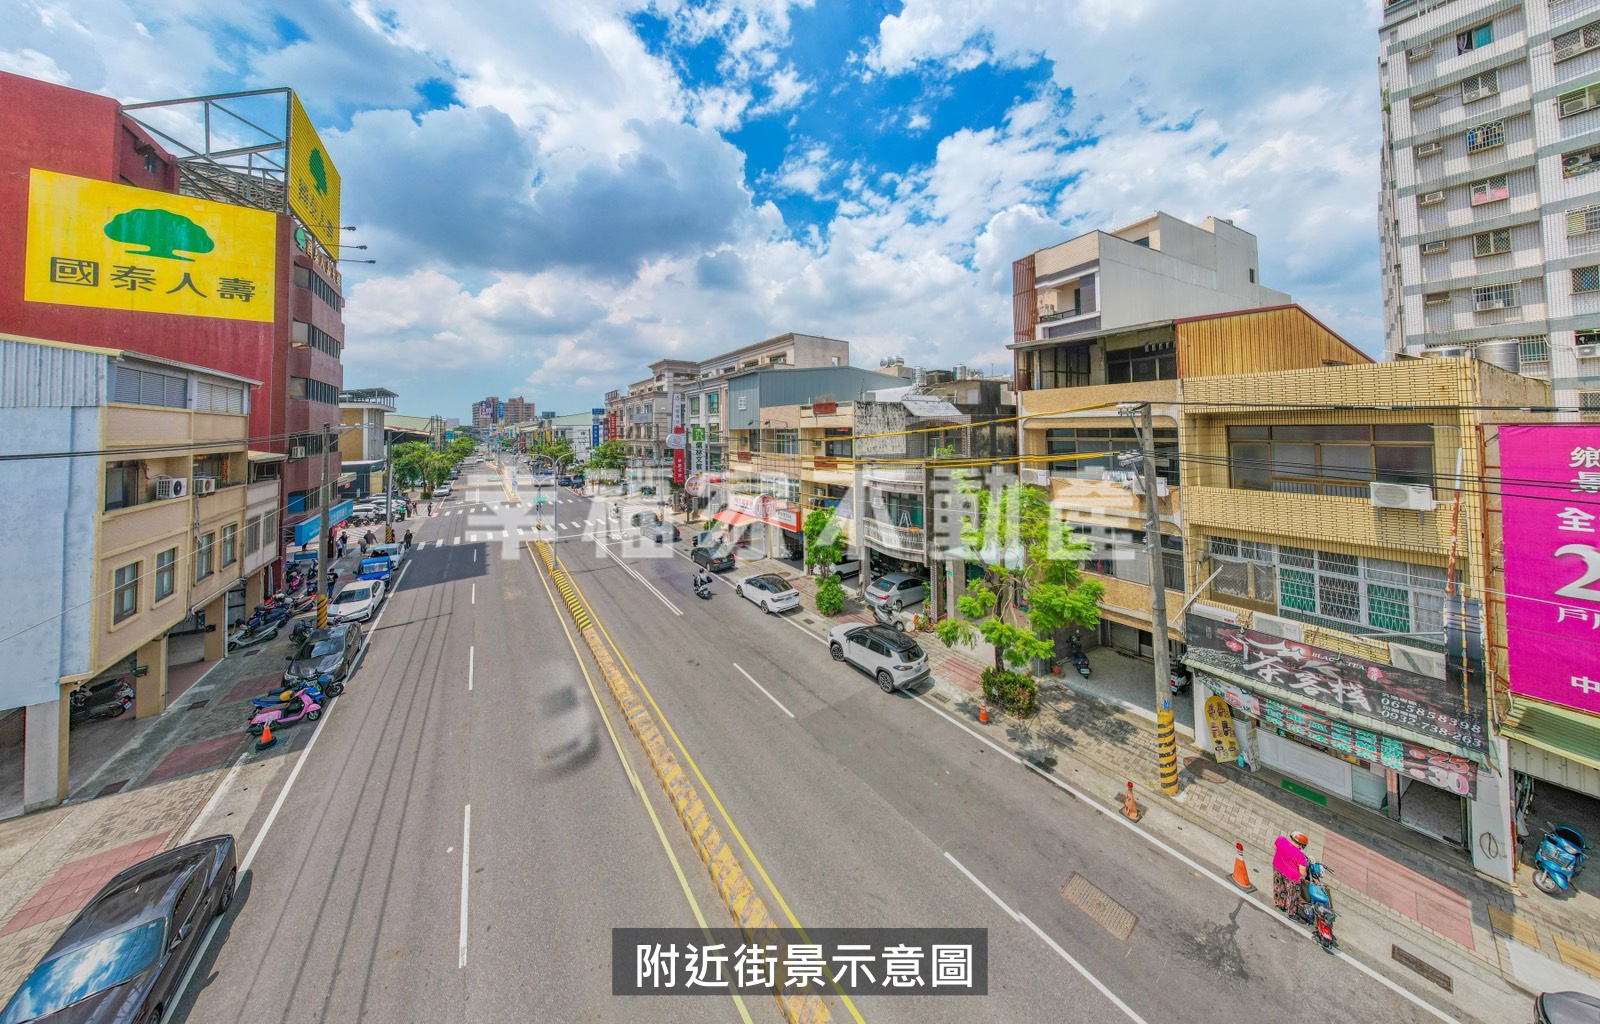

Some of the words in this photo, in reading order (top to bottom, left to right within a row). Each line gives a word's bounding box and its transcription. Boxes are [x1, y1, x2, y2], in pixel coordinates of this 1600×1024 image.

[50, 256, 256, 303] 國泰人壽
[1311, 652, 1342, 665] BLAC
[1345, 662, 1365, 671] TEA
[1244, 650, 1373, 712] 茶客棧
[1381, 697, 1481, 734] 06-5858398
[1381, 710, 1482, 747] 0932-738-263
[1427, 749, 1470, 774] 25
[1428, 766, 1469, 795] 30
